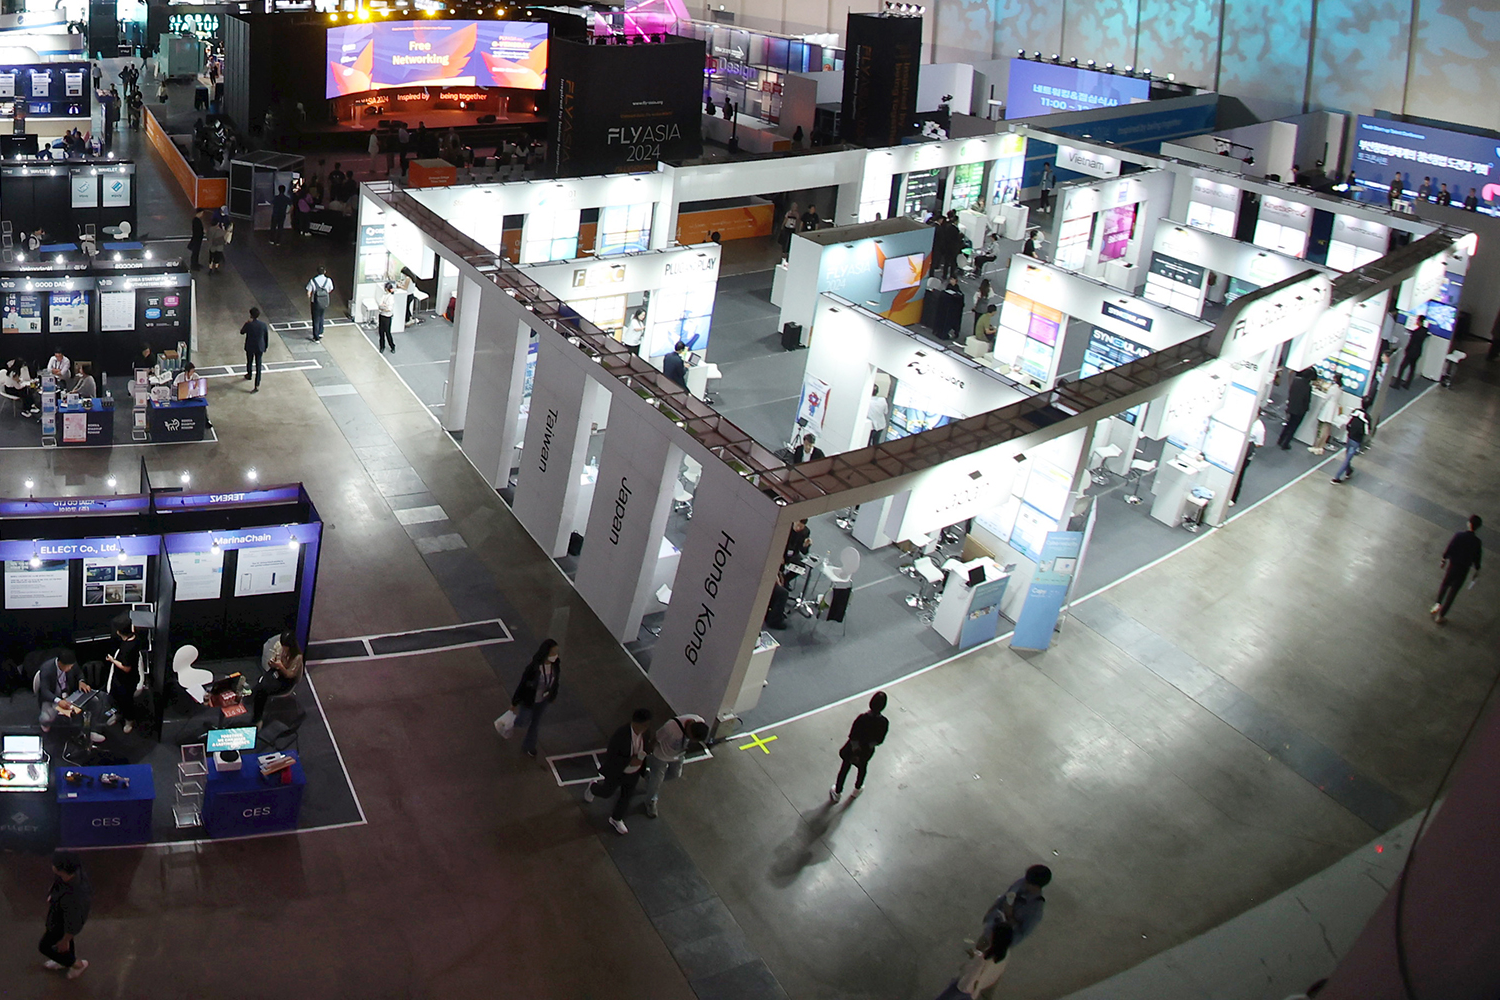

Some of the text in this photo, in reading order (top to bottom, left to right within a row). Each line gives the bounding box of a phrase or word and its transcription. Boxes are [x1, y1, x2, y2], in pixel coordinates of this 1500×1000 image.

[168, 23, 219, 31] STATUP
[408, 41, 431, 52] Free
[392, 53, 449, 66] Networking
[719, 56, 757, 80] Design
[397, 92, 430, 101] Inspired by
[440, 92, 487, 100] being together
[608, 123, 680, 145] FLYASIA
[626, 144, 660, 162] 2024
[1069, 152, 1104, 171] Vietnam
[826, 261, 871, 281] FLYASIA
[826, 278, 846, 291] 2024
[538, 408, 559, 473] Taiwan
[609, 476, 633, 546] Japan
[214, 533, 272, 545] MarinaChain
[40, 545, 78, 554] ELLECT
[80, 545, 98, 554] Co.,
[684, 530, 736, 666] Hong Kong
[242, 806, 271, 818] CES
[92, 817, 121, 827] CES
